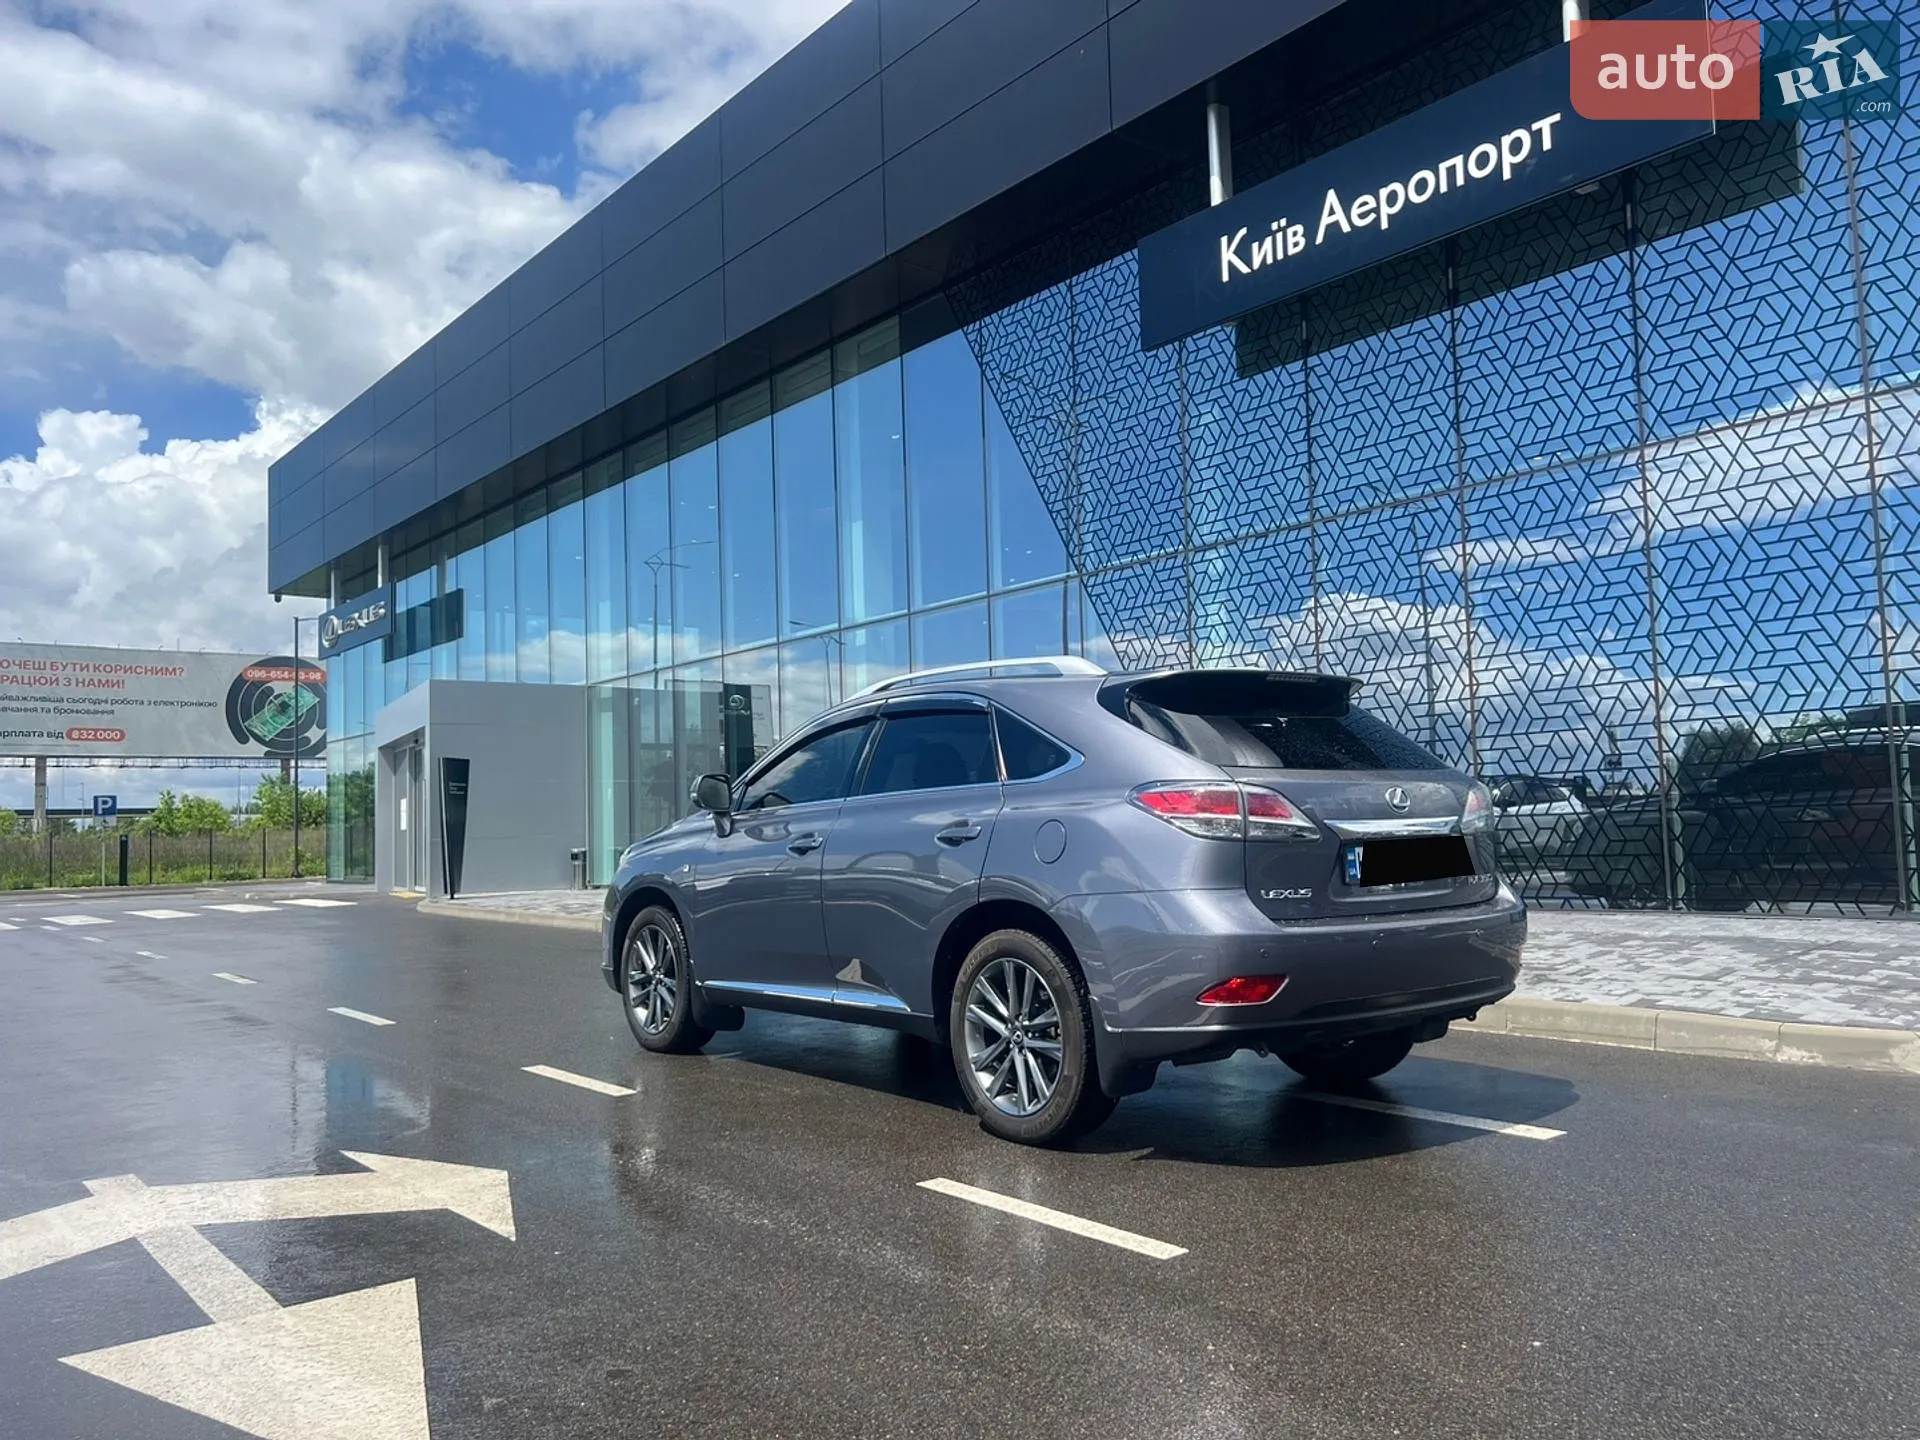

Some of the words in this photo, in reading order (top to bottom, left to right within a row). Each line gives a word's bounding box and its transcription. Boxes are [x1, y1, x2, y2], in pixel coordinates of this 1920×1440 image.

[1220, 217, 1306, 283] Київ
[1315, 112, 1562, 246] Аеропорт
[338, 601, 386, 634] LEXUS
[0, 659, 47, 671] ОЧЕШ
[50, 661, 90, 673] БУТИ
[93, 663, 185, 677] КОРИСНИМ?
[0, 673, 60, 688] РАЦЮЙ
[75, 678, 125, 689] НАМИ!
[46, 730, 64, 740] від
[97, 797, 113, 815] P
[1260, 888, 1312, 899] LEXUS
